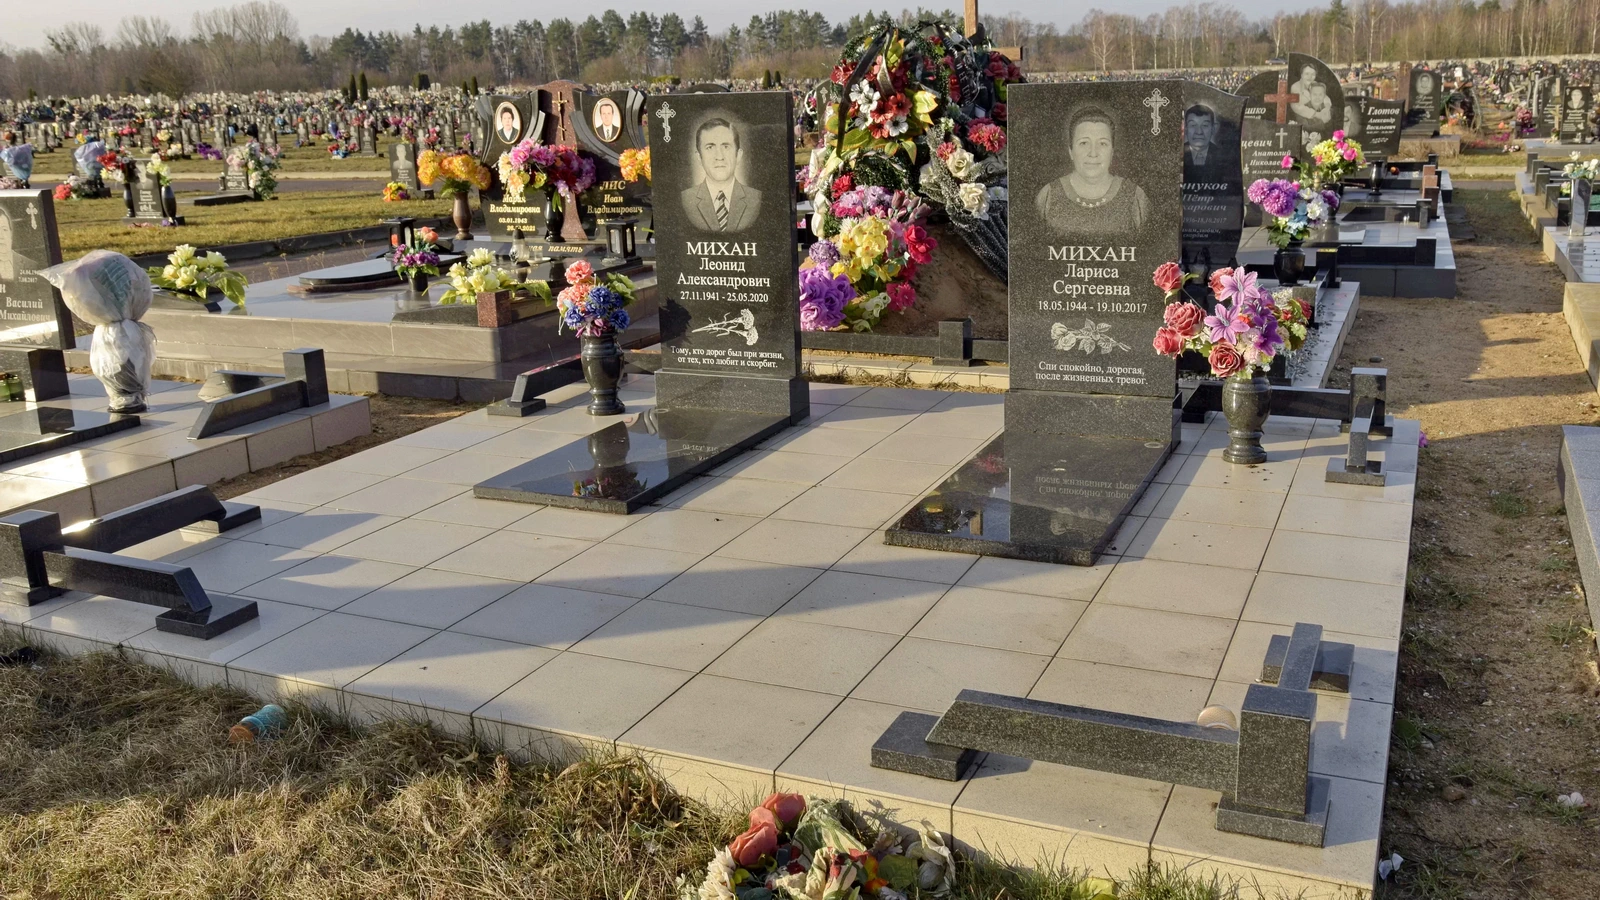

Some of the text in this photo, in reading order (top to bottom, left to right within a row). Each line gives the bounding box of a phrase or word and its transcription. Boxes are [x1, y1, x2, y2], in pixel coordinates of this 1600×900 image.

[1367, 106, 1400, 116] Глотов
[1241, 139, 1273, 149] цевич
[599, 180, 626, 190] ЛИС
[604, 194, 624, 203] Иван
[489, 203, 541, 215] Владимировна
[587, 205, 643, 215] Владимирович
[548, 245, 583, 253] память
[686, 241, 758, 257] МИХАН
[1048, 245, 1137, 262] МИХАН
[699, 257, 746, 273] Леонид
[1064, 263, 1120, 281] Лариса
[677, 272, 771, 289] Александрович
[1053, 280, 1131, 298] Сергеевна
[6, 296, 43, 309] Василий
[680, 291, 719, 301] 27.11.1941
[727, 292, 769, 303] 25.05.2020
[1038, 300, 1087, 312] 18.05.1944
[1097, 302, 1148, 313] 19.10.2017
[0, 309, 51, 322] Михайлович
[671, 346, 691, 356] Тому,
[706, 349, 725, 358] дорог
[727, 348, 742, 357] был
[744, 351, 757, 360] при
[759, 352, 785, 360] жизни,
[687, 356, 701, 365] тех,
[716, 357, 739, 366] любит
[746, 359, 778, 369] скорбит.
[1038, 361, 1145, 376] Спи спокойно, дорогая,
[1035, 373, 1149, 386] после жизненных тревог.
